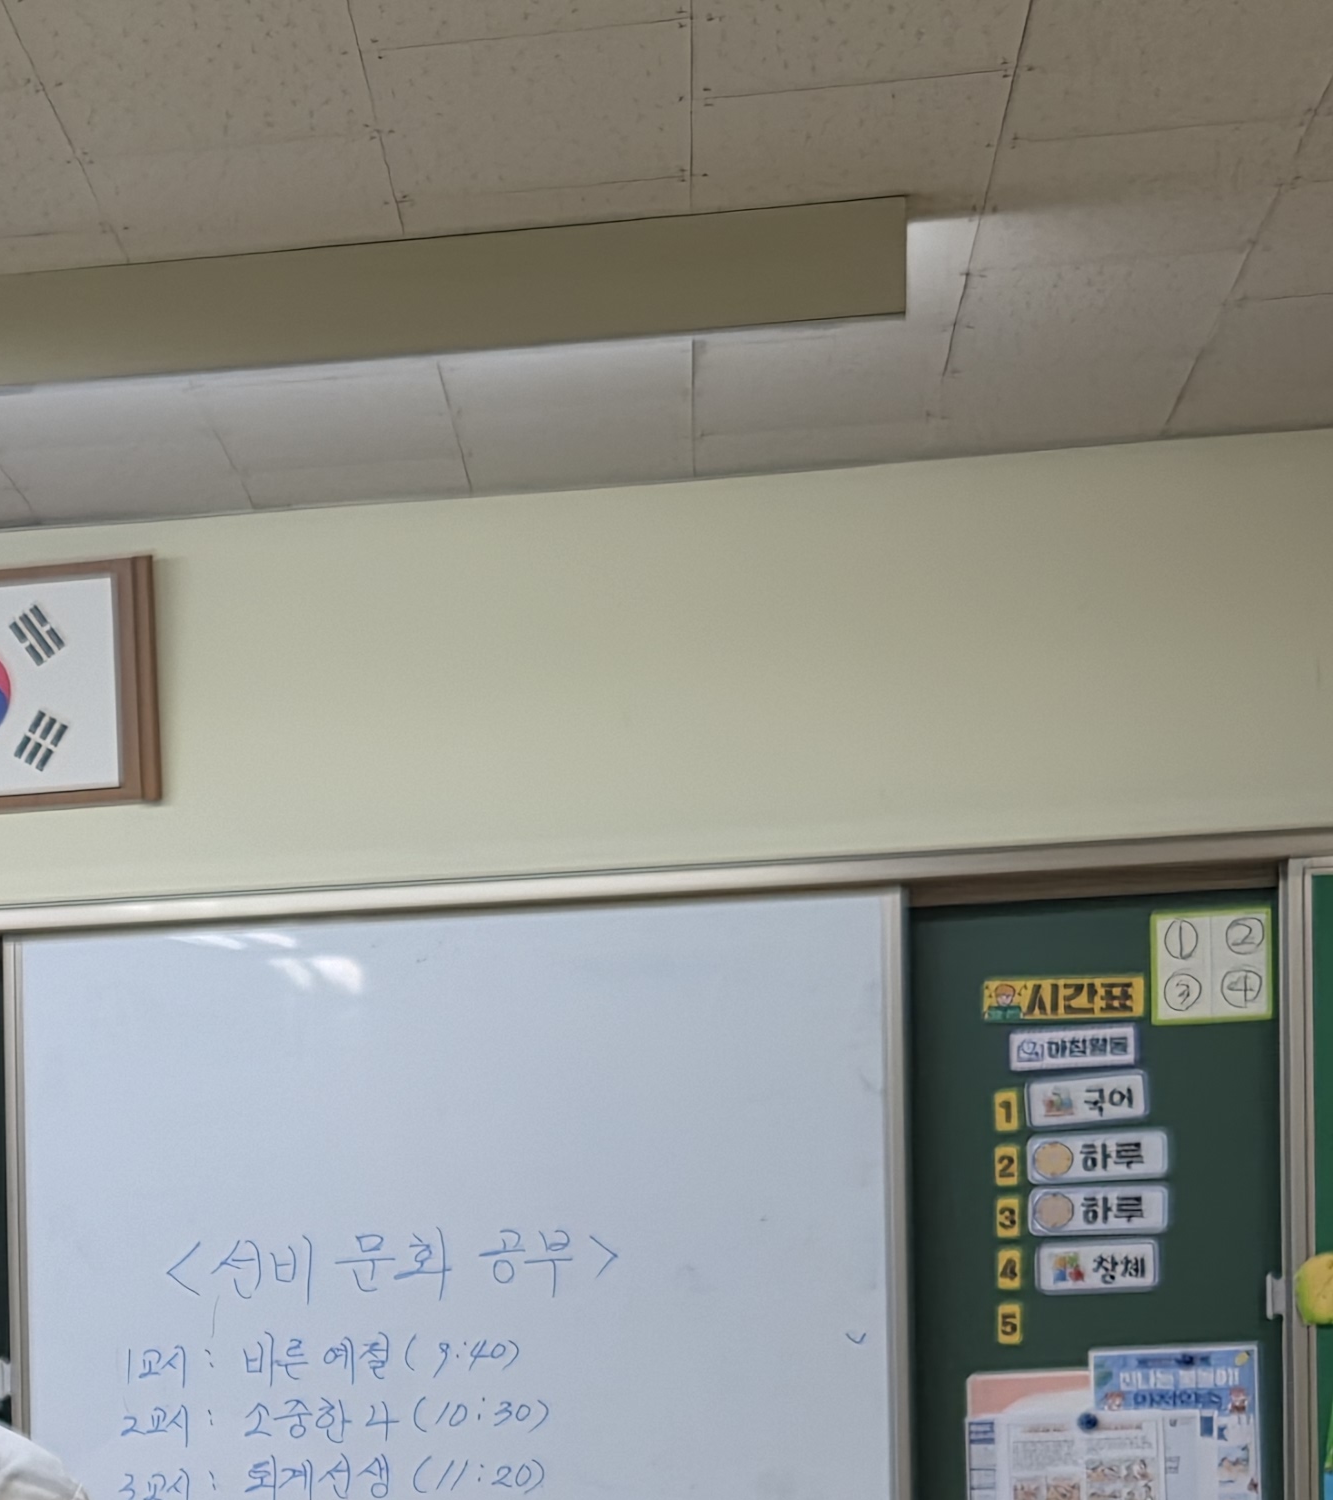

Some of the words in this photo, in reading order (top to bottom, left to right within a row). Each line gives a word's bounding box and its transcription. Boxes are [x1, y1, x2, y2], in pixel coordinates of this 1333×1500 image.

[1025, 982, 1134, 1016] 시간표
[998, 1099, 1013, 1123] 1
[1083, 1087, 1134, 1116] 국어
[998, 1155, 1015, 1179] 2
[1079, 1143, 1144, 1172] 하루
[998, 1207, 1017, 1229] 3
[1082, 1196, 1145, 1224] 하루
[335, 1226, 453, 1300] 문화
[999, 1258, 1018, 1279] 4
[1000, 1314, 1018, 1335] 5
[243, 1331, 309, 1387] 바른
[244, 1399, 351, 1444] 소중한
